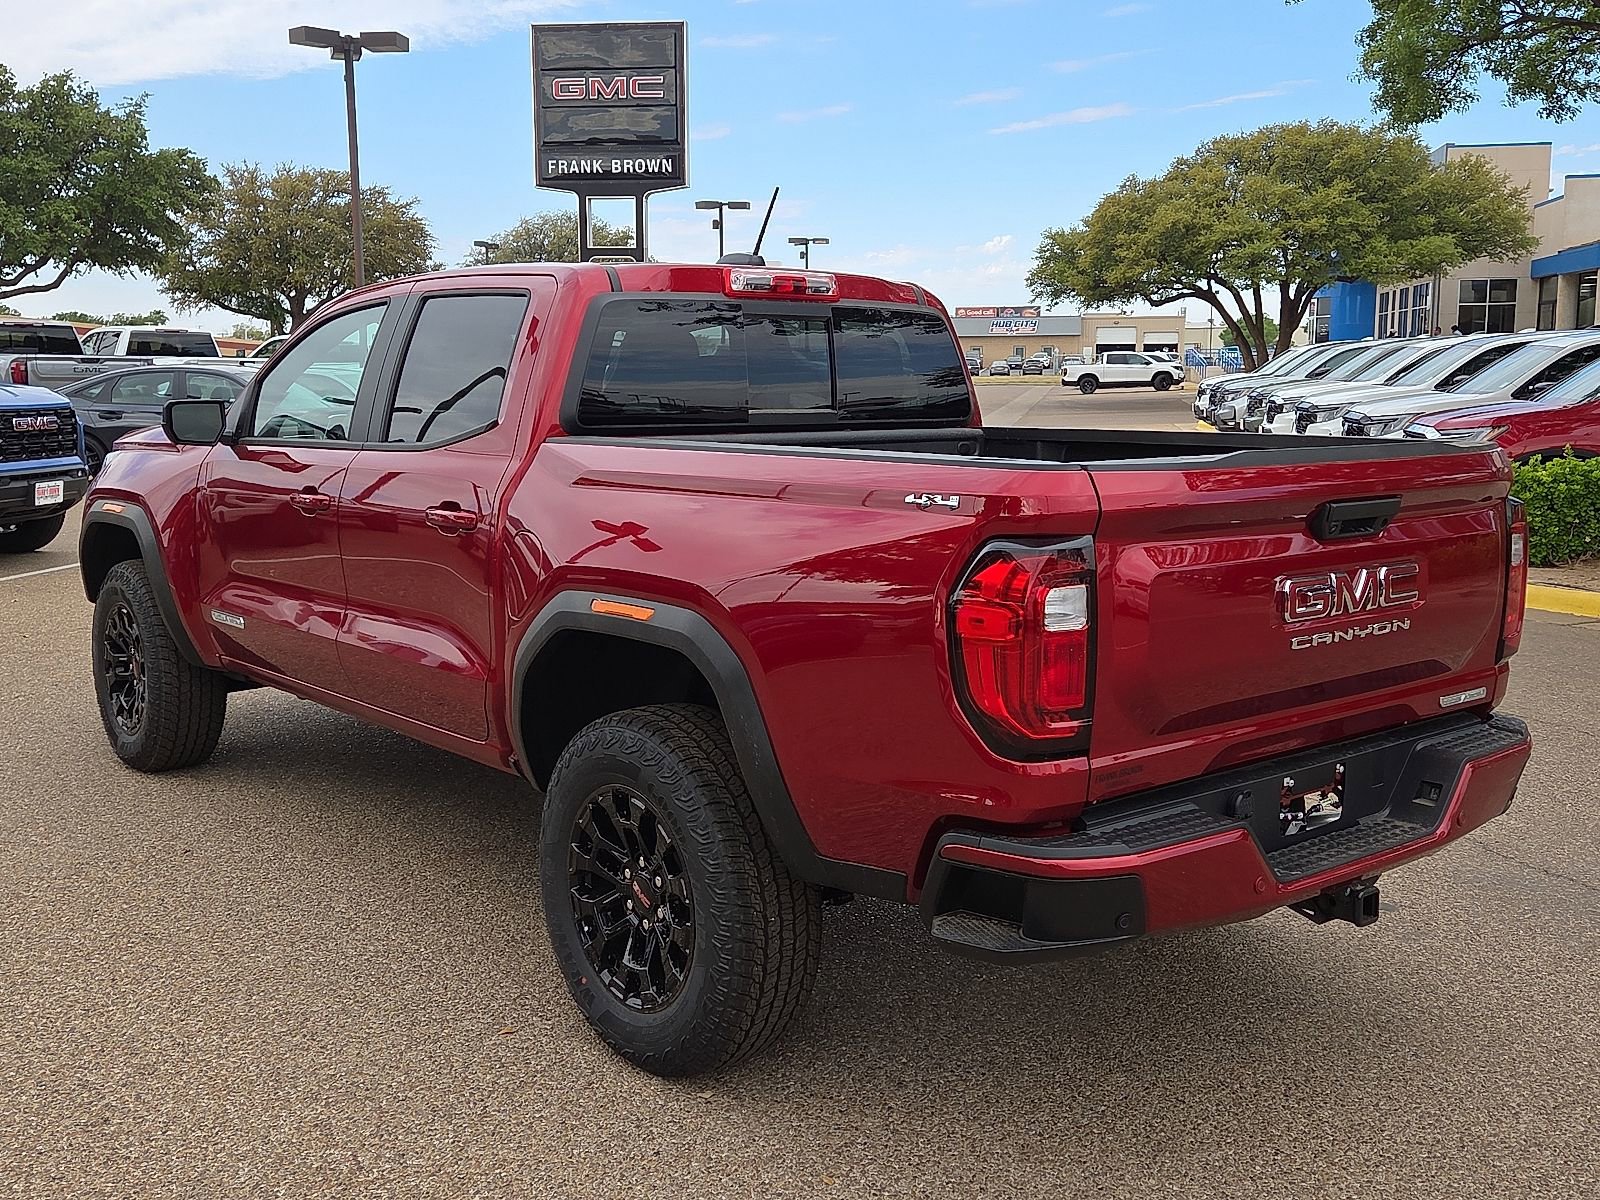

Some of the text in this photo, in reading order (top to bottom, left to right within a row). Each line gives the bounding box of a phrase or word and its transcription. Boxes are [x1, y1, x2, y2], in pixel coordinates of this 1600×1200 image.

[552, 76, 664, 100] GMC
[548, 158, 673, 174] FRANK BROWN
[991, 320, 1038, 328] HUB CITY
[13, 416, 59, 431] GMC
[1275, 561, 1420, 624] GMC
[1290, 617, 1411, 650] CANYON
